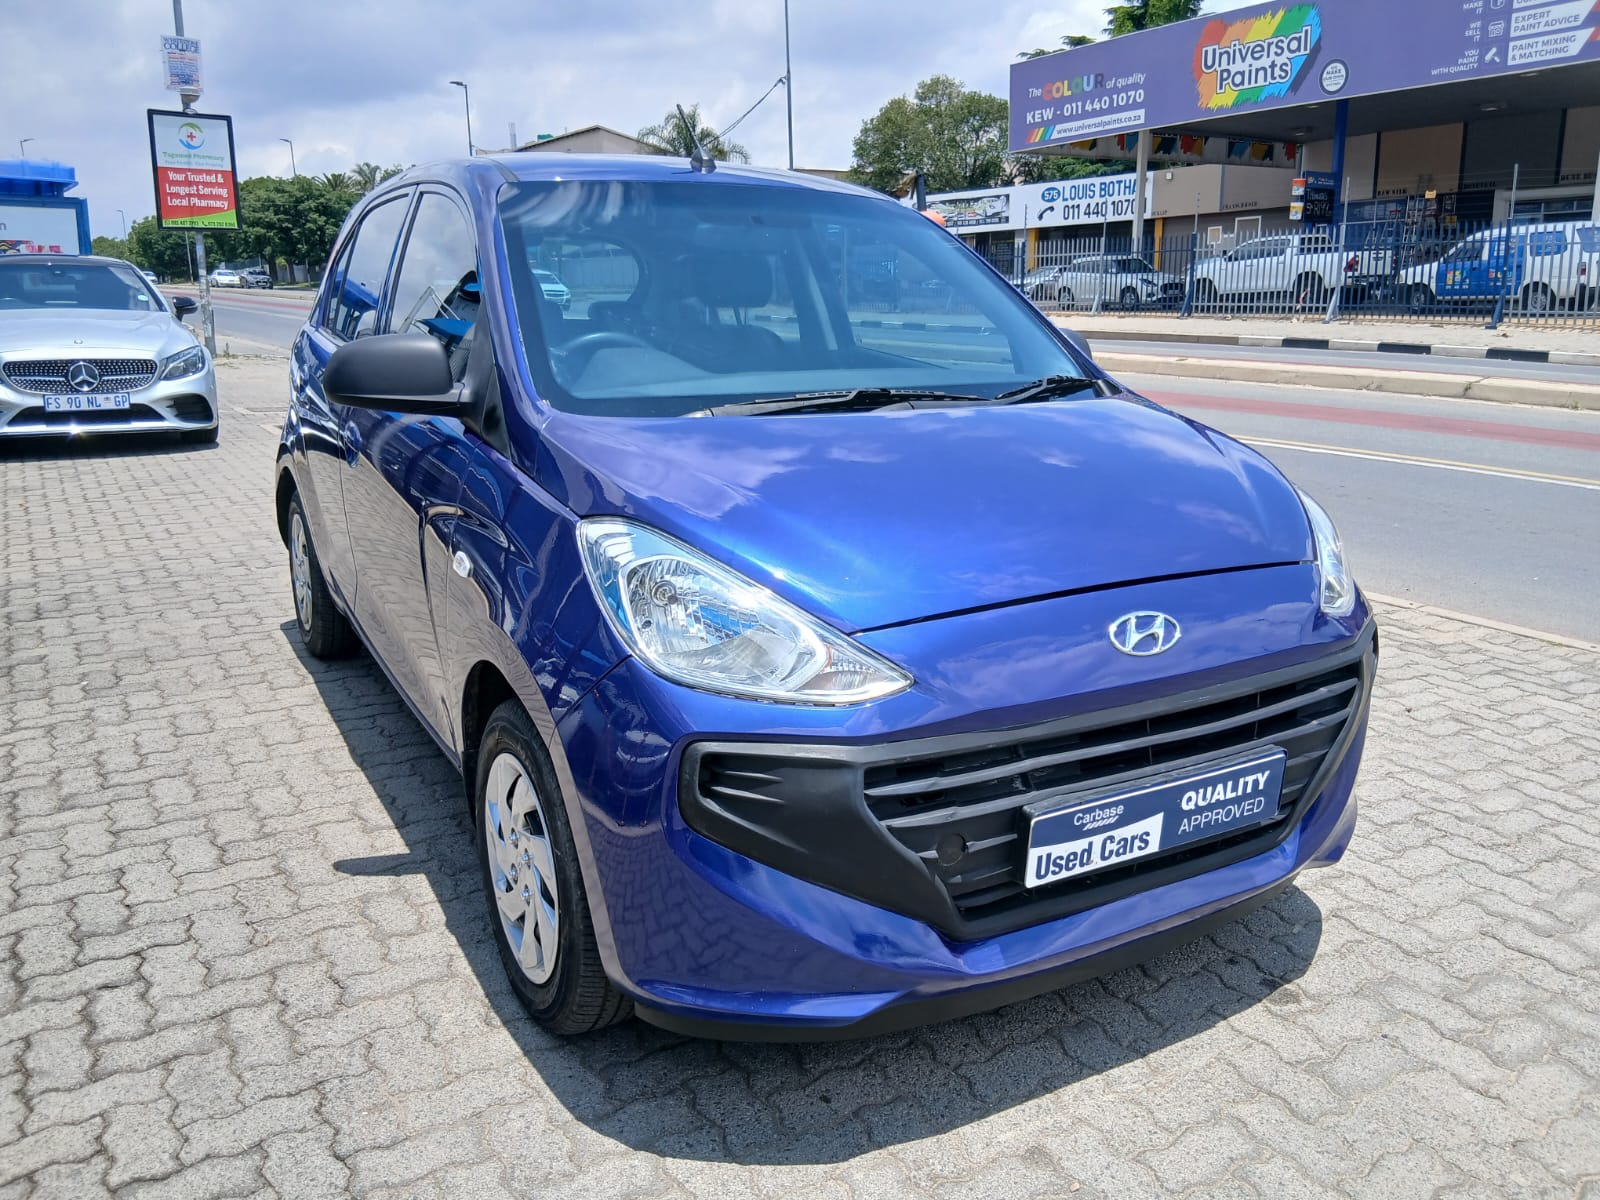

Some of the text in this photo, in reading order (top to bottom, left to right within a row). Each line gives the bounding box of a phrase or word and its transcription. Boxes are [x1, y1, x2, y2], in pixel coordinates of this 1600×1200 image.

[1463, 1, 1483, 9] MAKE
[1470, 21, 1481, 29] WE
[1513, 14, 1580, 33] PAINT ADVICE
[1514, 10, 1551, 24] EXPERT
[1464, 29, 1480, 37] SELL
[1203, 28, 1310, 71] Universal
[1464, 49, 1479, 57] YOU
[1511, 34, 1577, 53] PAINT MIXING
[1518, 46, 1569, 60] MATCHING
[1431, 63, 1479, 76] WITH QUALITY
[1457, 56, 1479, 65] PAINT
[1218, 60, 1290, 91] Paints
[1028, 72, 1146, 101] The COLOUR of quality
[1026, 107, 1055, 125] KEW
[1063, 101, 1082, 117] 011
[1085, 96, 1109, 112] 440
[1112, 89, 1145, 107] 1070
[1056, 114, 1141, 135] www.universalpaints.co.za
[168, 171, 224, 182] Your Trusted &
[166, 184, 229, 198] Longest Serving
[1044, 190, 1060, 200] 575
[1062, 183, 1096, 202] LOUIS
[168, 197, 229, 210] Local Pharmacy
[1063, 203, 1081, 220] 011
[1084, 201, 1108, 218] 440
[46, 395, 128, 409] FS 90 NL GP
[1180, 770, 1271, 812] QUALITY
[1073, 804, 1124, 827] Carbase
[1178, 797, 1265, 836] APPROVED
[1035, 830, 1151, 881] Used Cars
